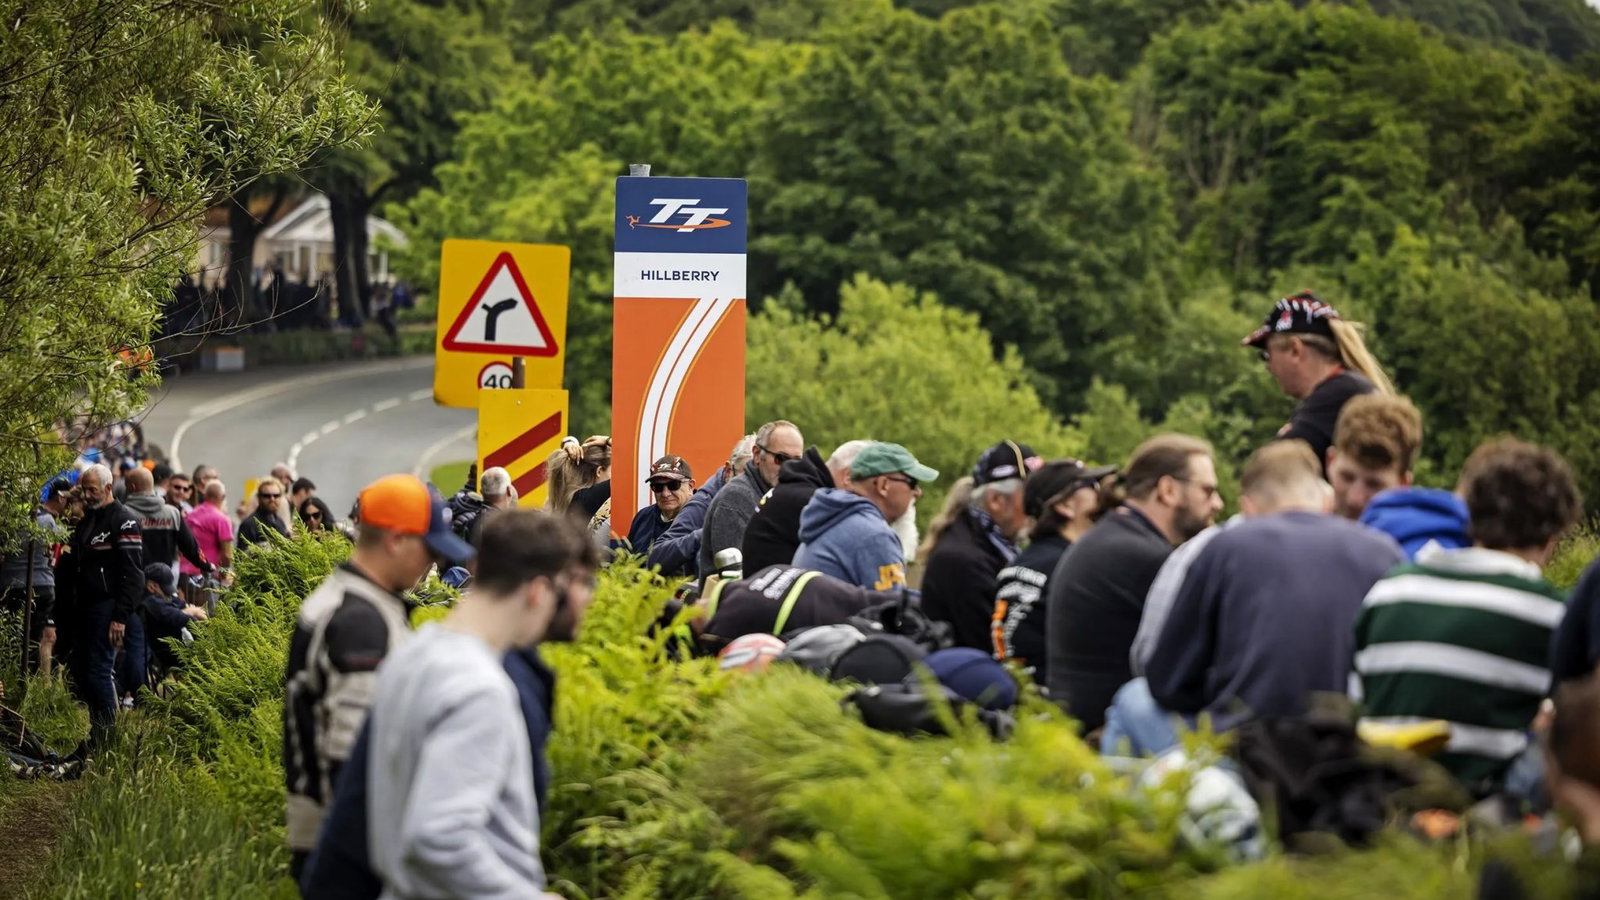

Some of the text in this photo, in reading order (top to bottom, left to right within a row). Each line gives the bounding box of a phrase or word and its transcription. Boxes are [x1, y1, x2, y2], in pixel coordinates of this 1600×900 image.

[649, 198, 729, 232] TT
[641, 270, 719, 281] HILLBERRY
[484, 374, 513, 389] 40
